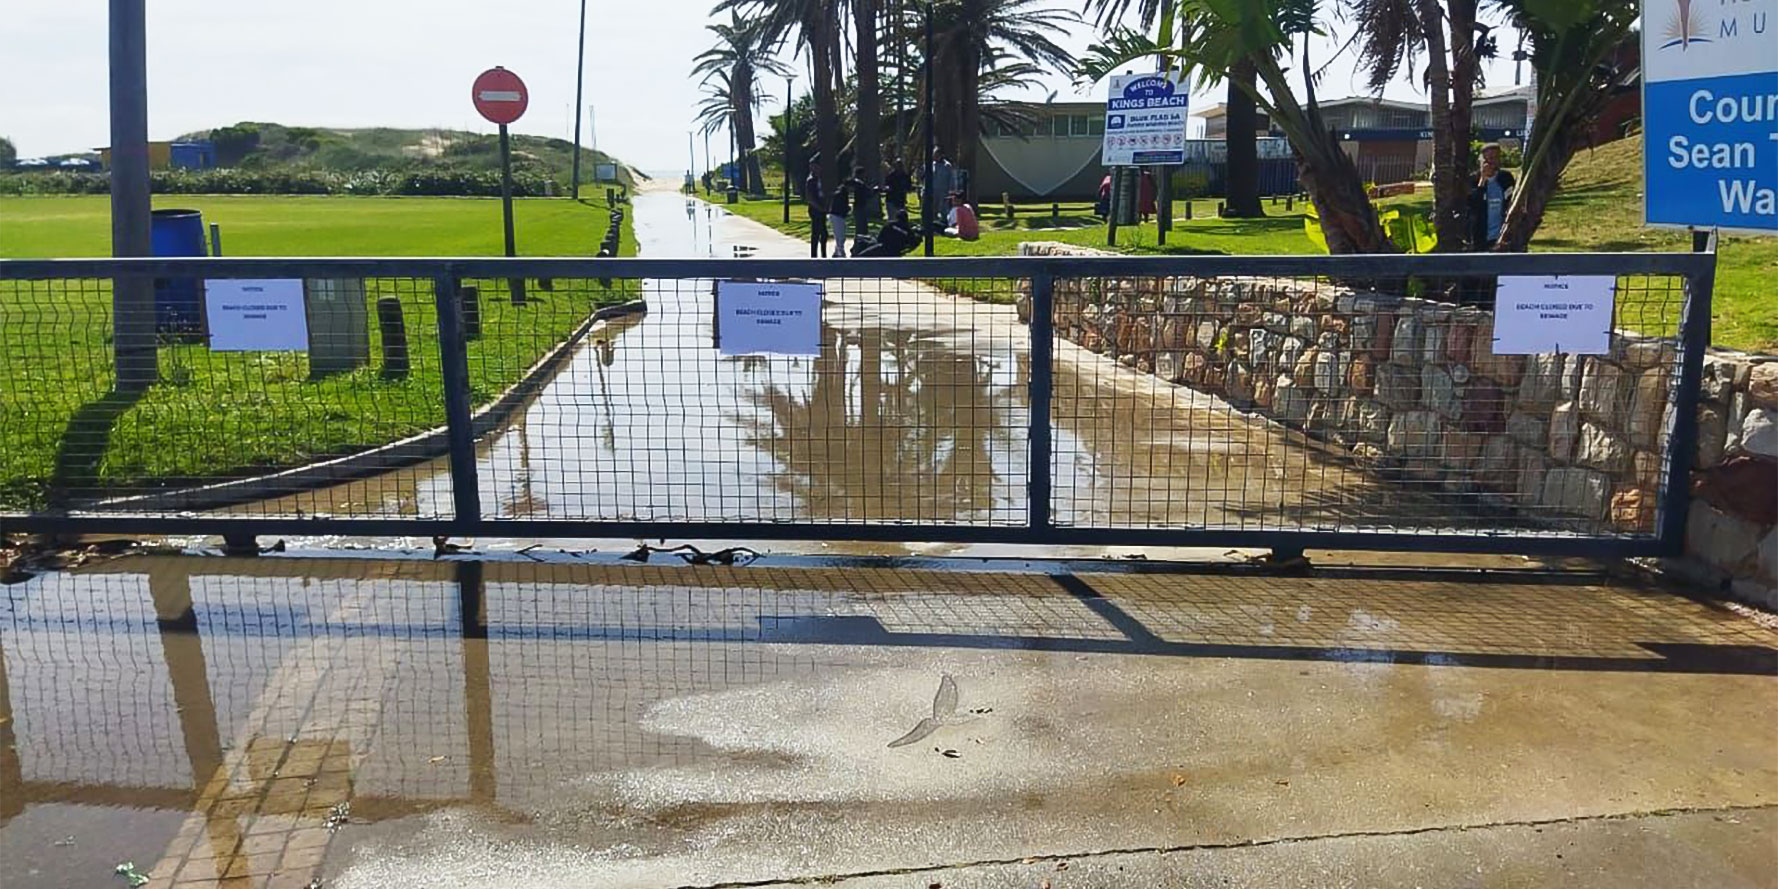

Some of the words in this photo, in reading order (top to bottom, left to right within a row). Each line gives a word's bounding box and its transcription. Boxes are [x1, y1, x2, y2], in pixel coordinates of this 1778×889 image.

[1112, 98, 1145, 109] KINGS
[1147, 96, 1184, 107] BEACH
[1668, 135, 1755, 169] Sean
